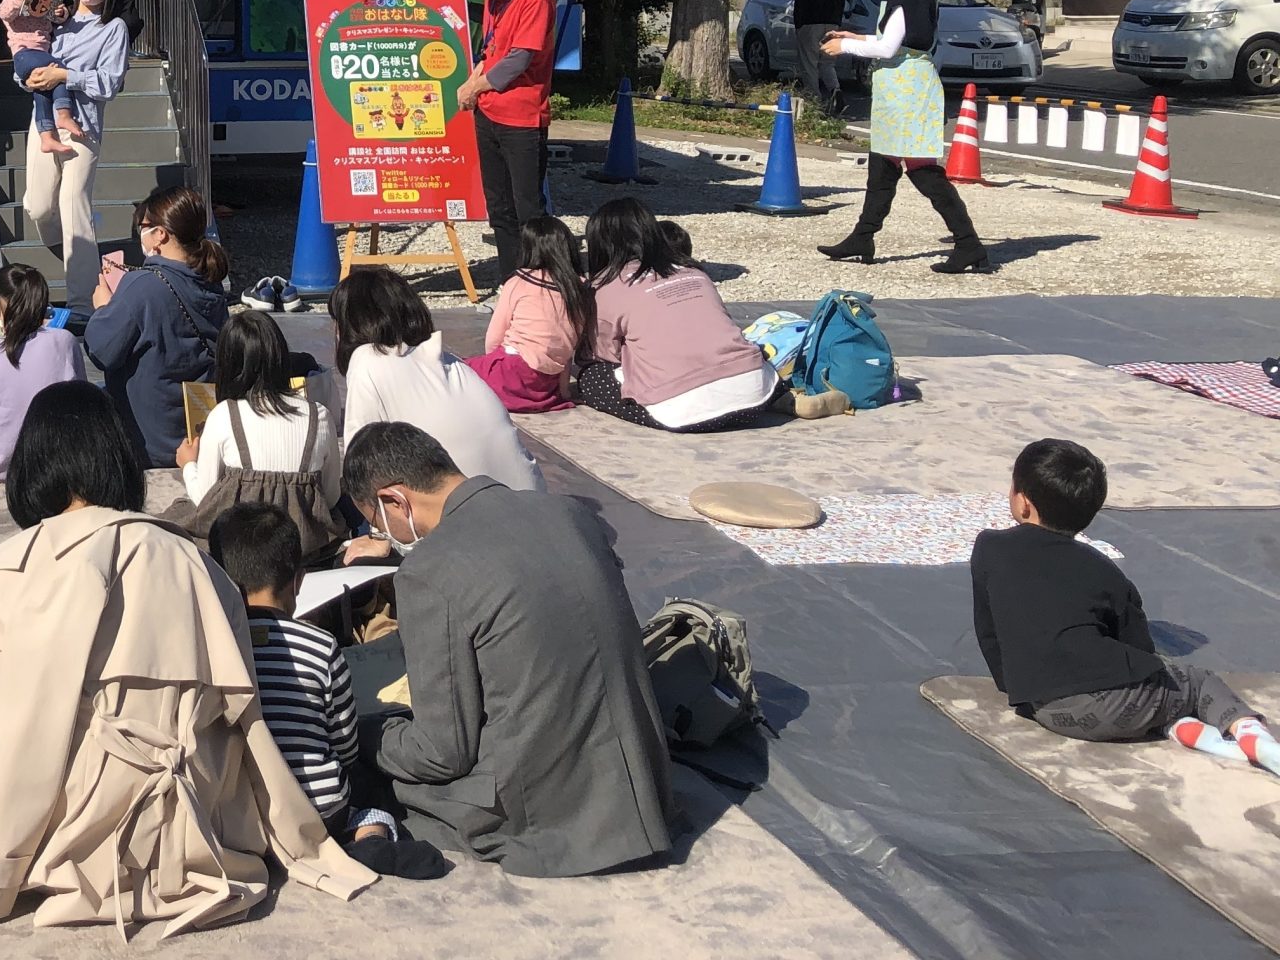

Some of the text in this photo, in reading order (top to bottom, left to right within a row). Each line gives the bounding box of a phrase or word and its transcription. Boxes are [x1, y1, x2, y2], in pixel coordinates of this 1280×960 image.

[364, 8, 428, 21] おはなし隊
[343, 54, 380, 79] 20
[233, 79, 312, 101] KODA
[376, 146, 408, 155] 全国訪問
[410, 146, 450, 154] おはなし隊
